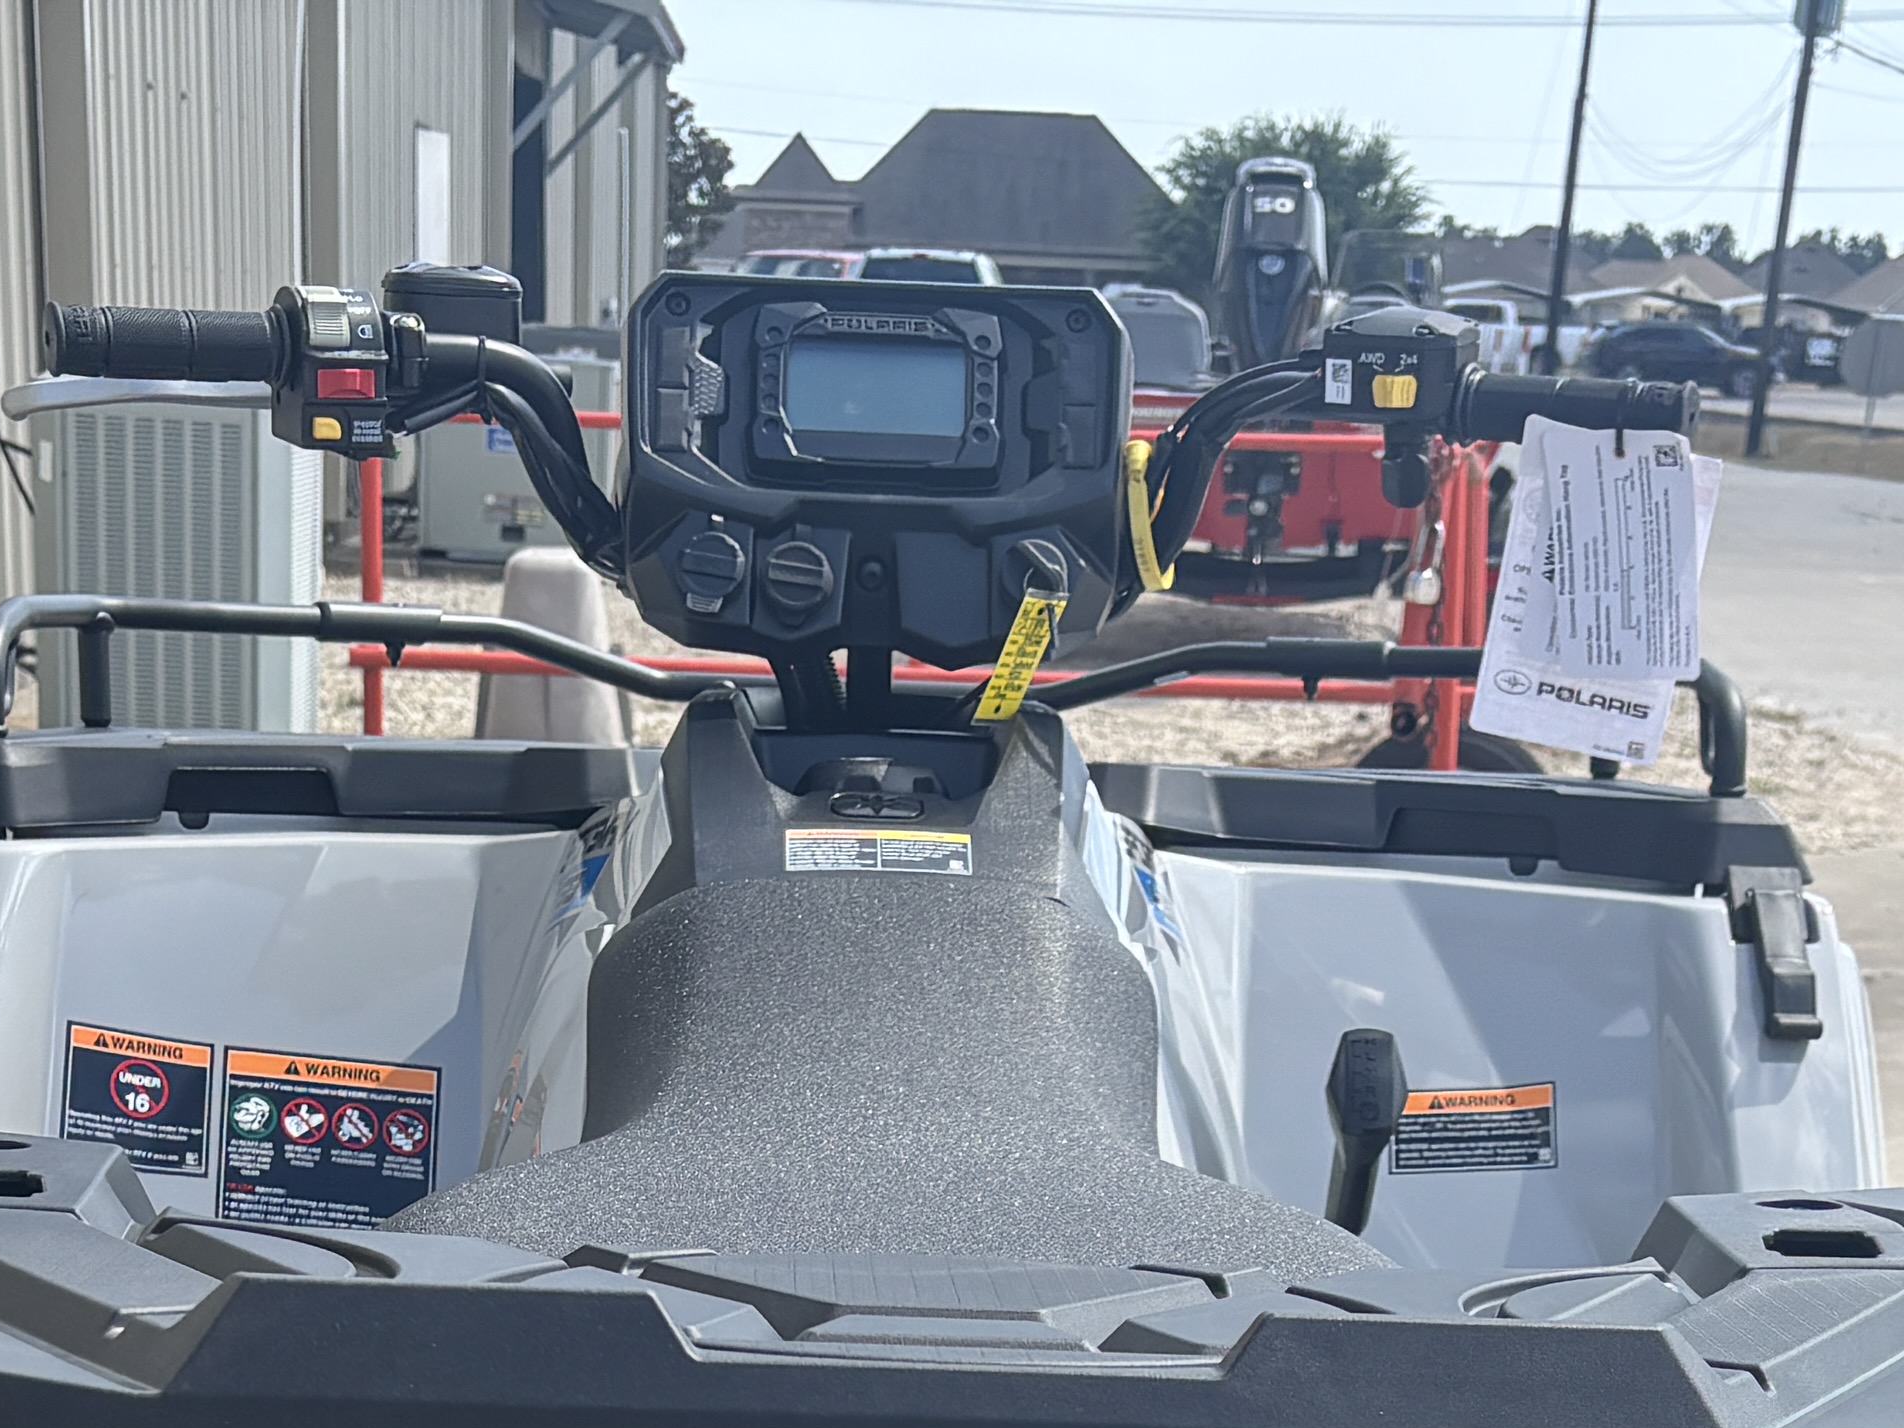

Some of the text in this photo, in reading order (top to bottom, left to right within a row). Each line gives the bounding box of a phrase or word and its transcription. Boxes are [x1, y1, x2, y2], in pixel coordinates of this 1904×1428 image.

[831, 317, 929, 332] POLARIS
[1357, 352, 1386, 365] AWD
[1536, 681, 1651, 720] POLARIS
[111, 1035, 184, 1060] WARNING
[118, 1071, 162, 1089] UNDER
[304, 1062, 382, 1083] WARNING
[124, 1092, 151, 1114] 16
[1443, 1093, 1517, 1109] WARNING
